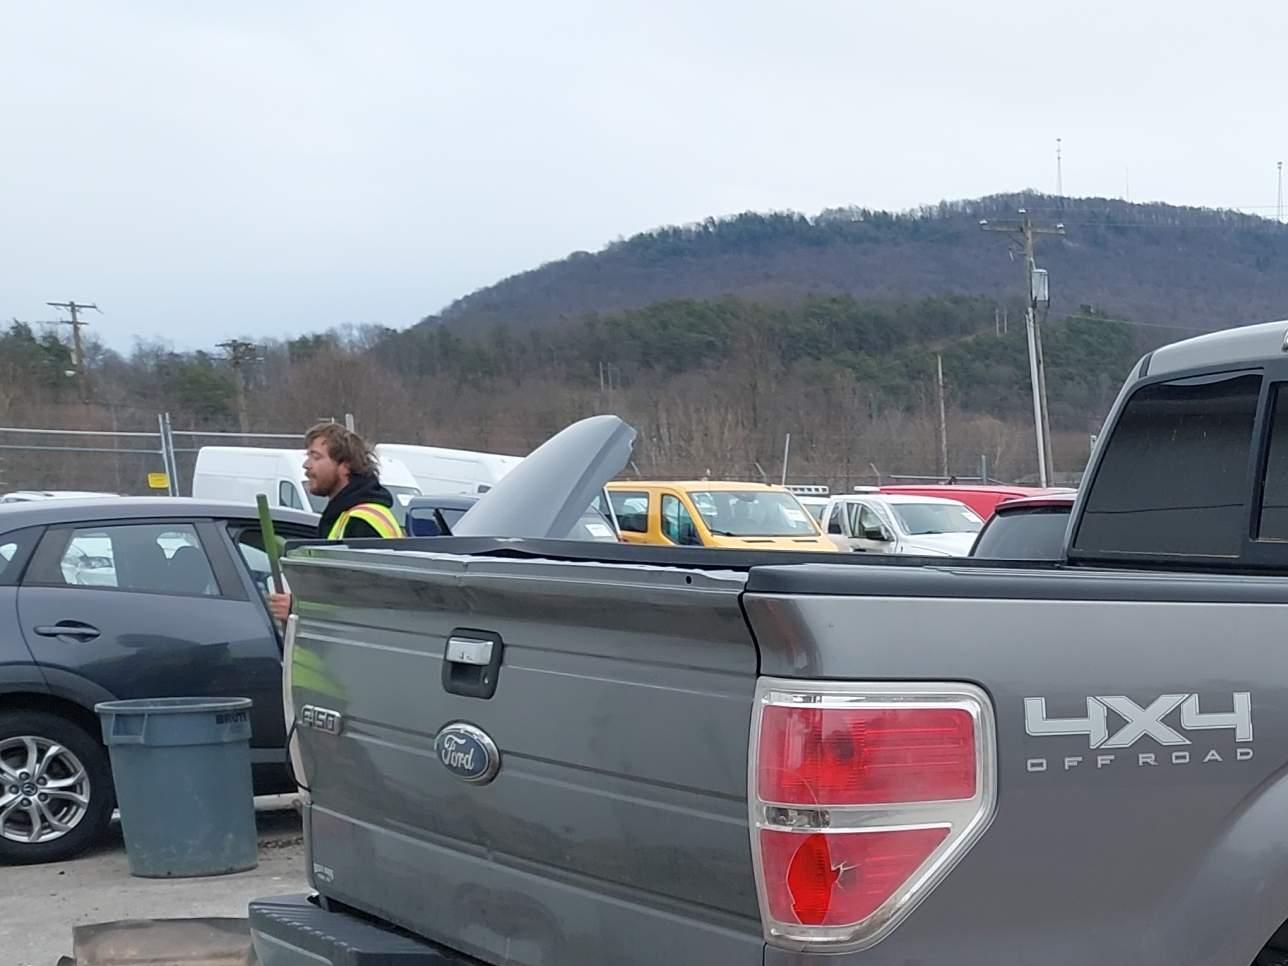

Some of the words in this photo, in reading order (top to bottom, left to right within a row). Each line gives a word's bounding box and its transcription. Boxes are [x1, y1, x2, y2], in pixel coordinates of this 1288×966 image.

[1024, 692, 1253, 749] 4X4
[441, 734, 474, 770] Ford
[1026, 755, 1116, 772] OFF
[1138, 748, 1254, 767] ROAD
